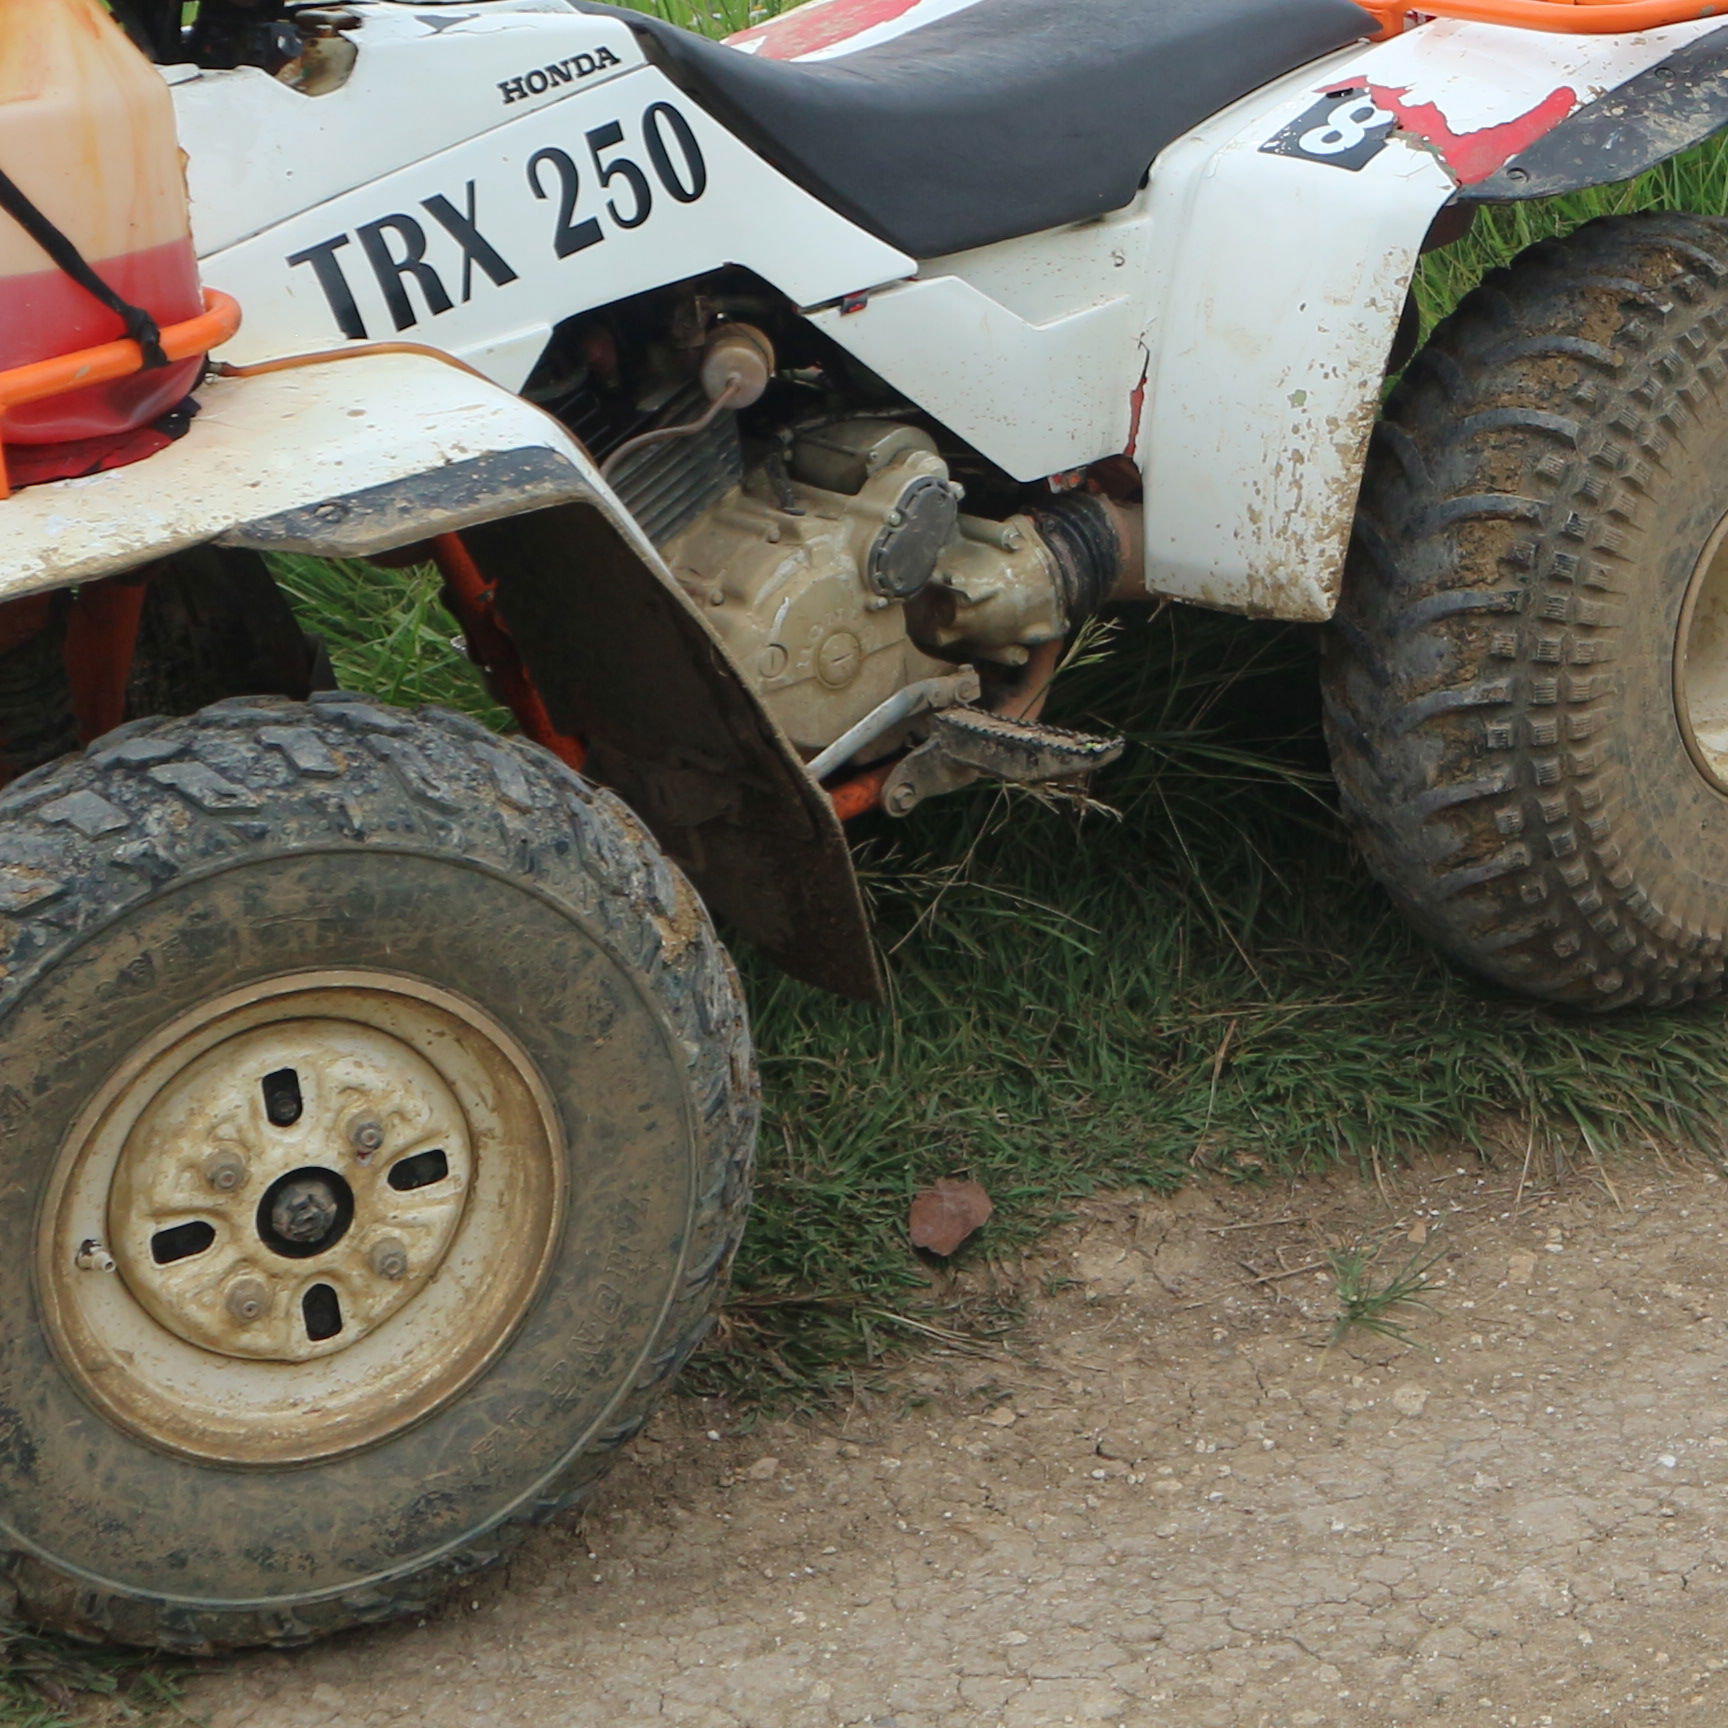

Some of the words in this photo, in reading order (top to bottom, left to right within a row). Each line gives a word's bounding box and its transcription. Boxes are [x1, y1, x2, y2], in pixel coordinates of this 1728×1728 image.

[497, 46, 621, 105] HONDA
[1298, 93, 1396, 156] 8
[286, 179, 519, 340] TRX
[526, 100, 708, 261] 250
